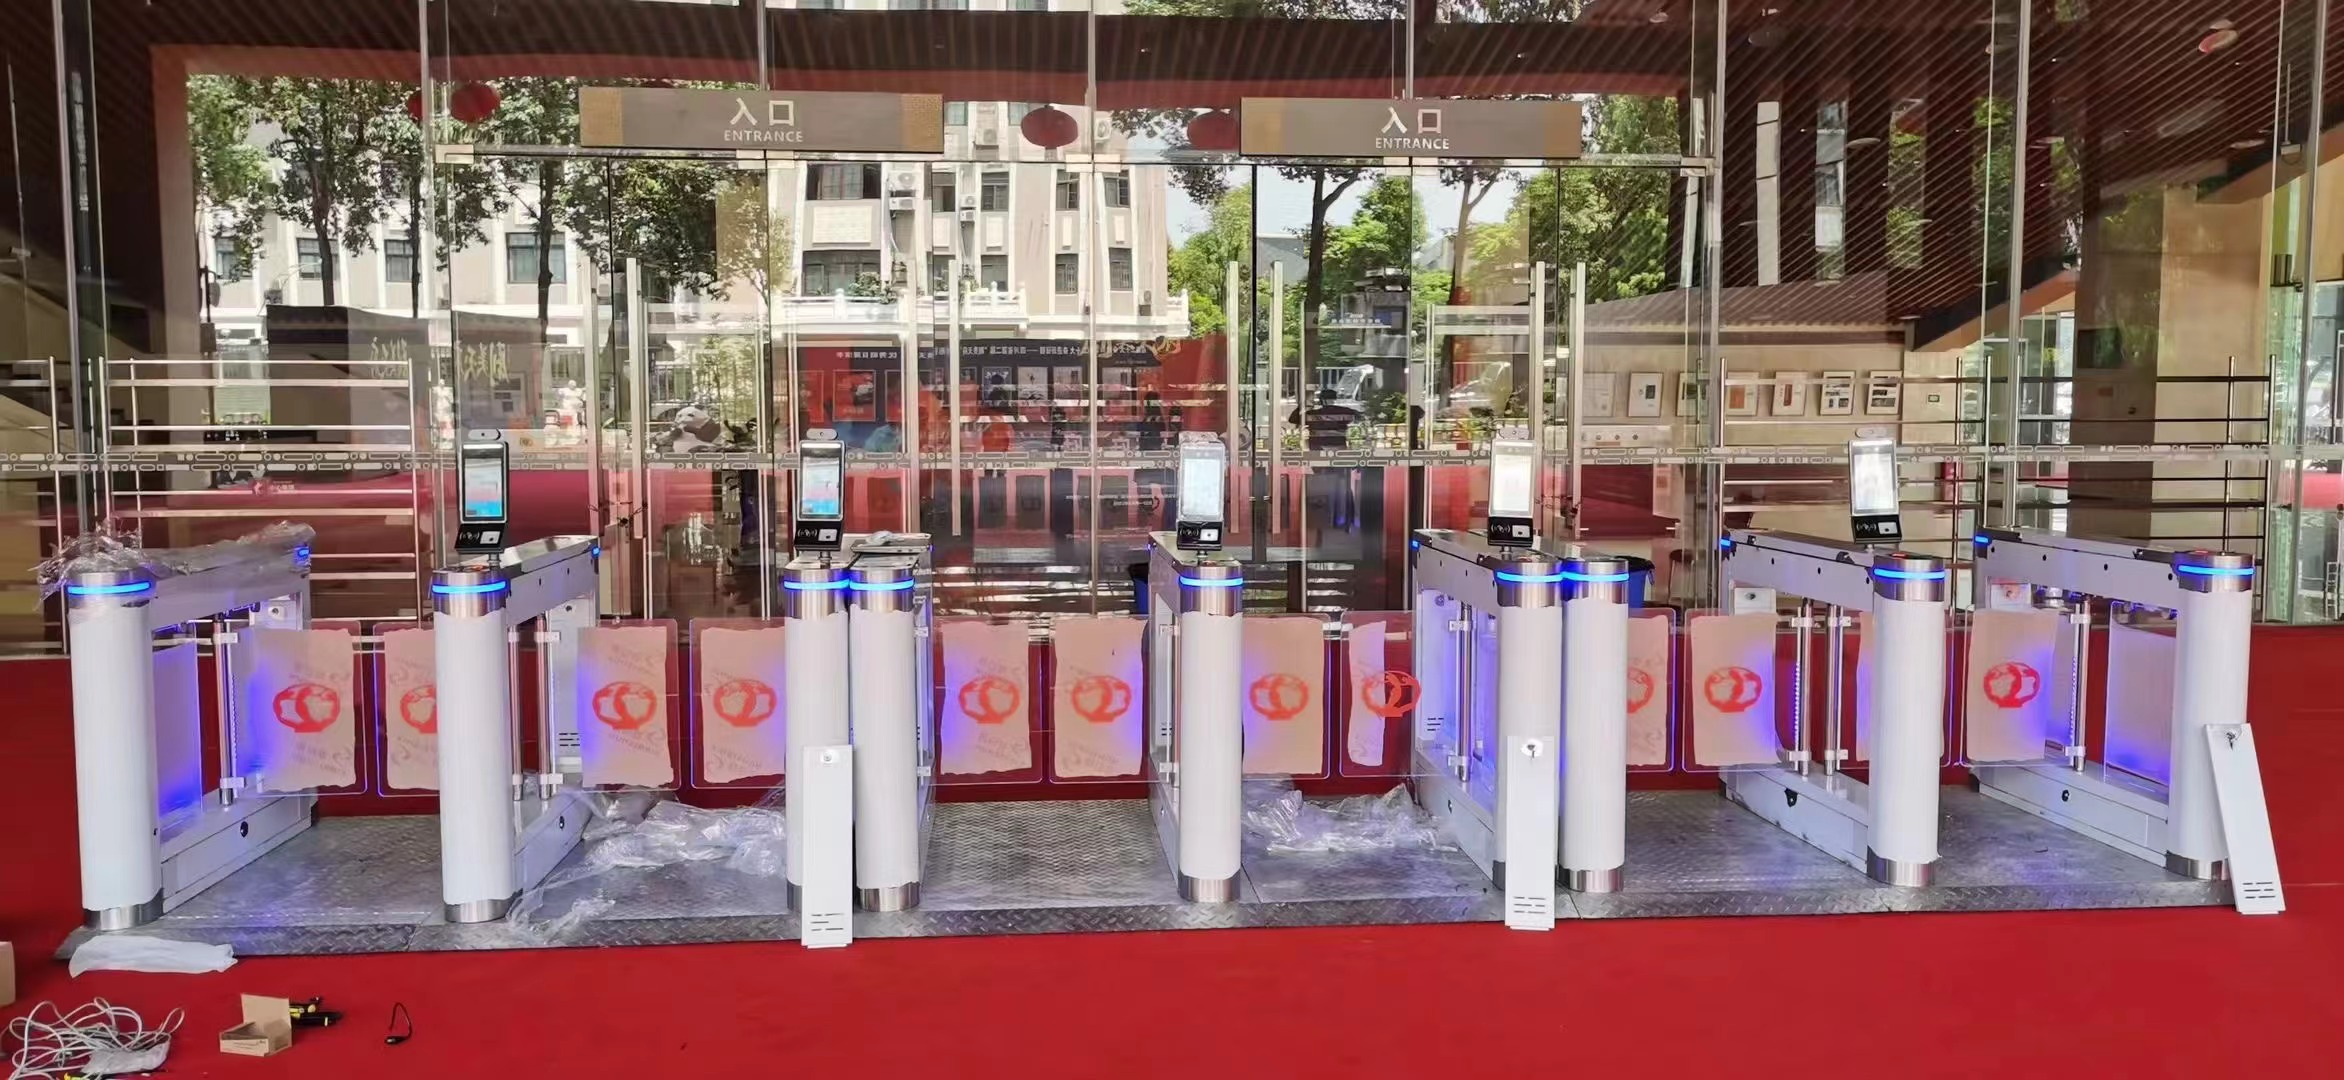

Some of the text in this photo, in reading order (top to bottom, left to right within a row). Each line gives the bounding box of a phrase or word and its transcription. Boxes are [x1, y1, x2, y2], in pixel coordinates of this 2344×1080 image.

[729, 97, 795, 126] 入口
[1381, 106, 1442, 134] 入口
[724, 130, 803, 143] ENTRANCE
[1375, 137, 1450, 150] ENTRANCE
